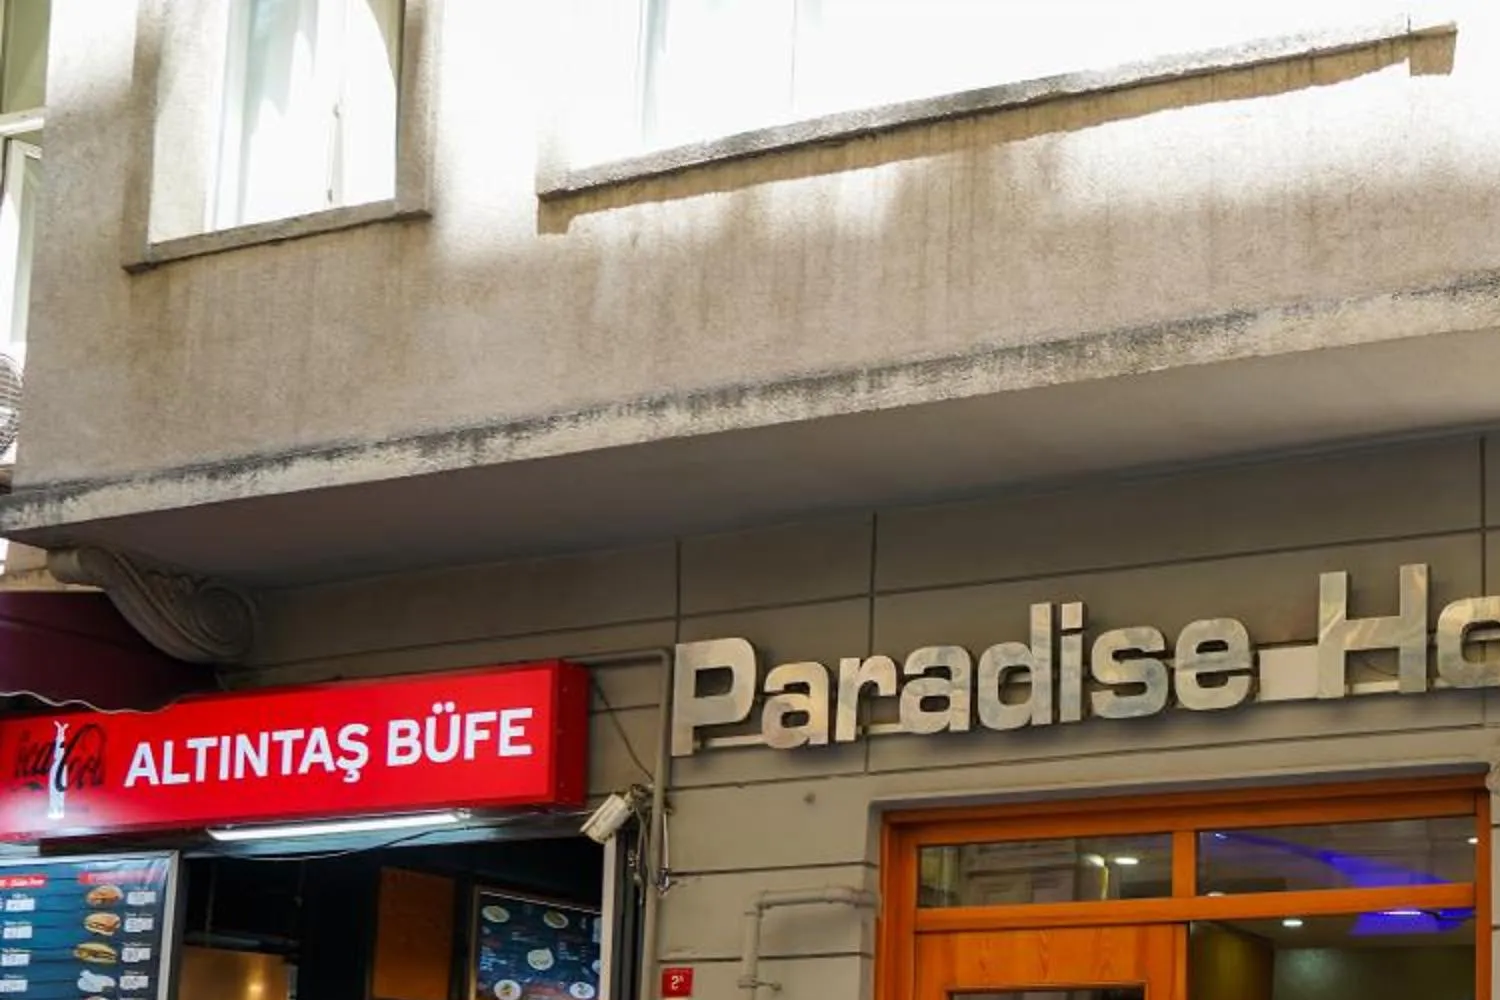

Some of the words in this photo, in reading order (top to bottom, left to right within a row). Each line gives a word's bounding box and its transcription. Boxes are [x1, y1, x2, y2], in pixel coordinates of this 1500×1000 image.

[671, 601, 1252, 757] Paradise
[124, 723, 371, 788] ALTINTAŞ
[387, 702, 534, 769] BÜFE
